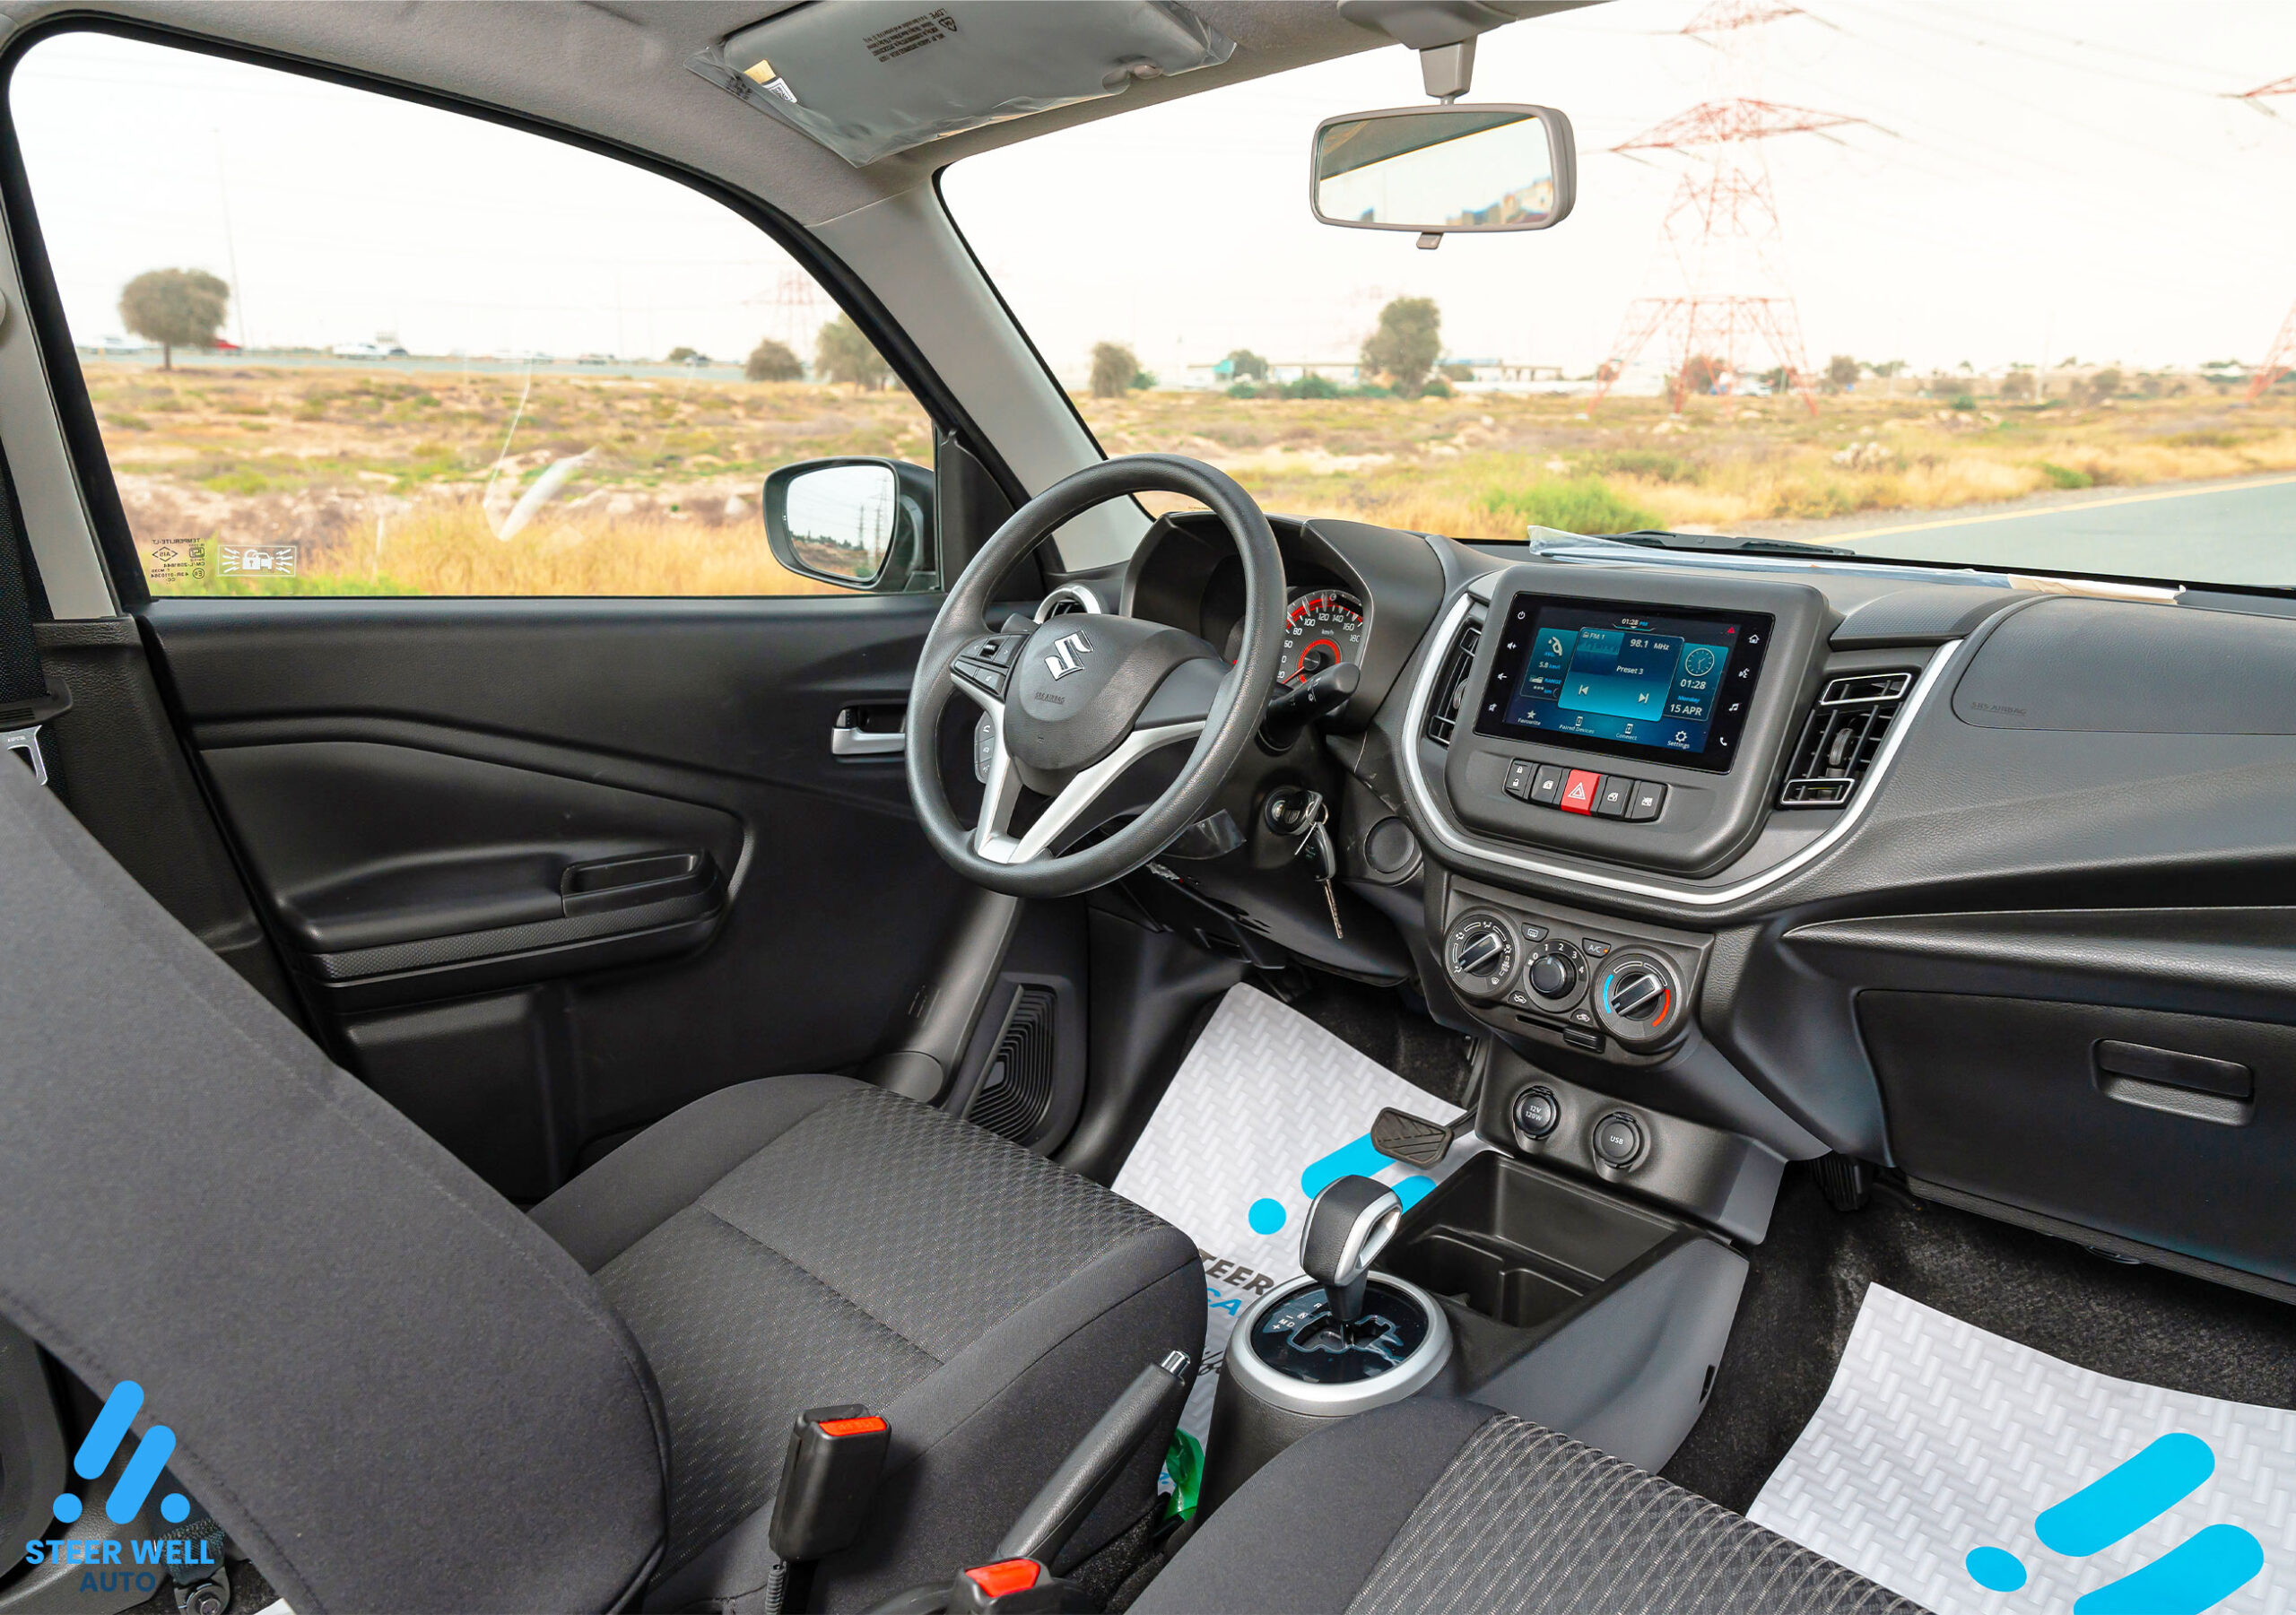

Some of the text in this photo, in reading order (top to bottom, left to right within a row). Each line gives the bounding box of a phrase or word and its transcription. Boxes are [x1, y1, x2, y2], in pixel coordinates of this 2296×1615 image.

[1318, 612, 1329, 621] 120
[1332, 614, 1344, 623] 140
[1304, 618, 1316, 627] 100
[1630, 638, 1670, 651] 98.1 MHz
[1616, 665, 1638, 674] Preset
[1680, 679, 1707, 690] 01:28
[1670, 704, 1702, 716] 15 APR
[1518, 717, 1542, 725] Favourite
[1576, 725, 1595, 734] Devices
[1615, 733, 1638, 741] Connect
[1667, 740, 1691, 750] Settings
[1544, 943, 1549, 951] 1
[1558, 943, 1565, 951] 2
[1587, 944, 1602, 954] A/C
[1571, 951, 1578, 959] 3
[1578, 966, 1585, 974] 4
[1529, 1105, 1542, 1114] 12V
[1525, 1111, 1543, 1122] 120W
[1610, 1135, 1623, 1145] USB
[1198, 1248, 1274, 1296] TEER
[1207, 1287, 1241, 1318] CA
